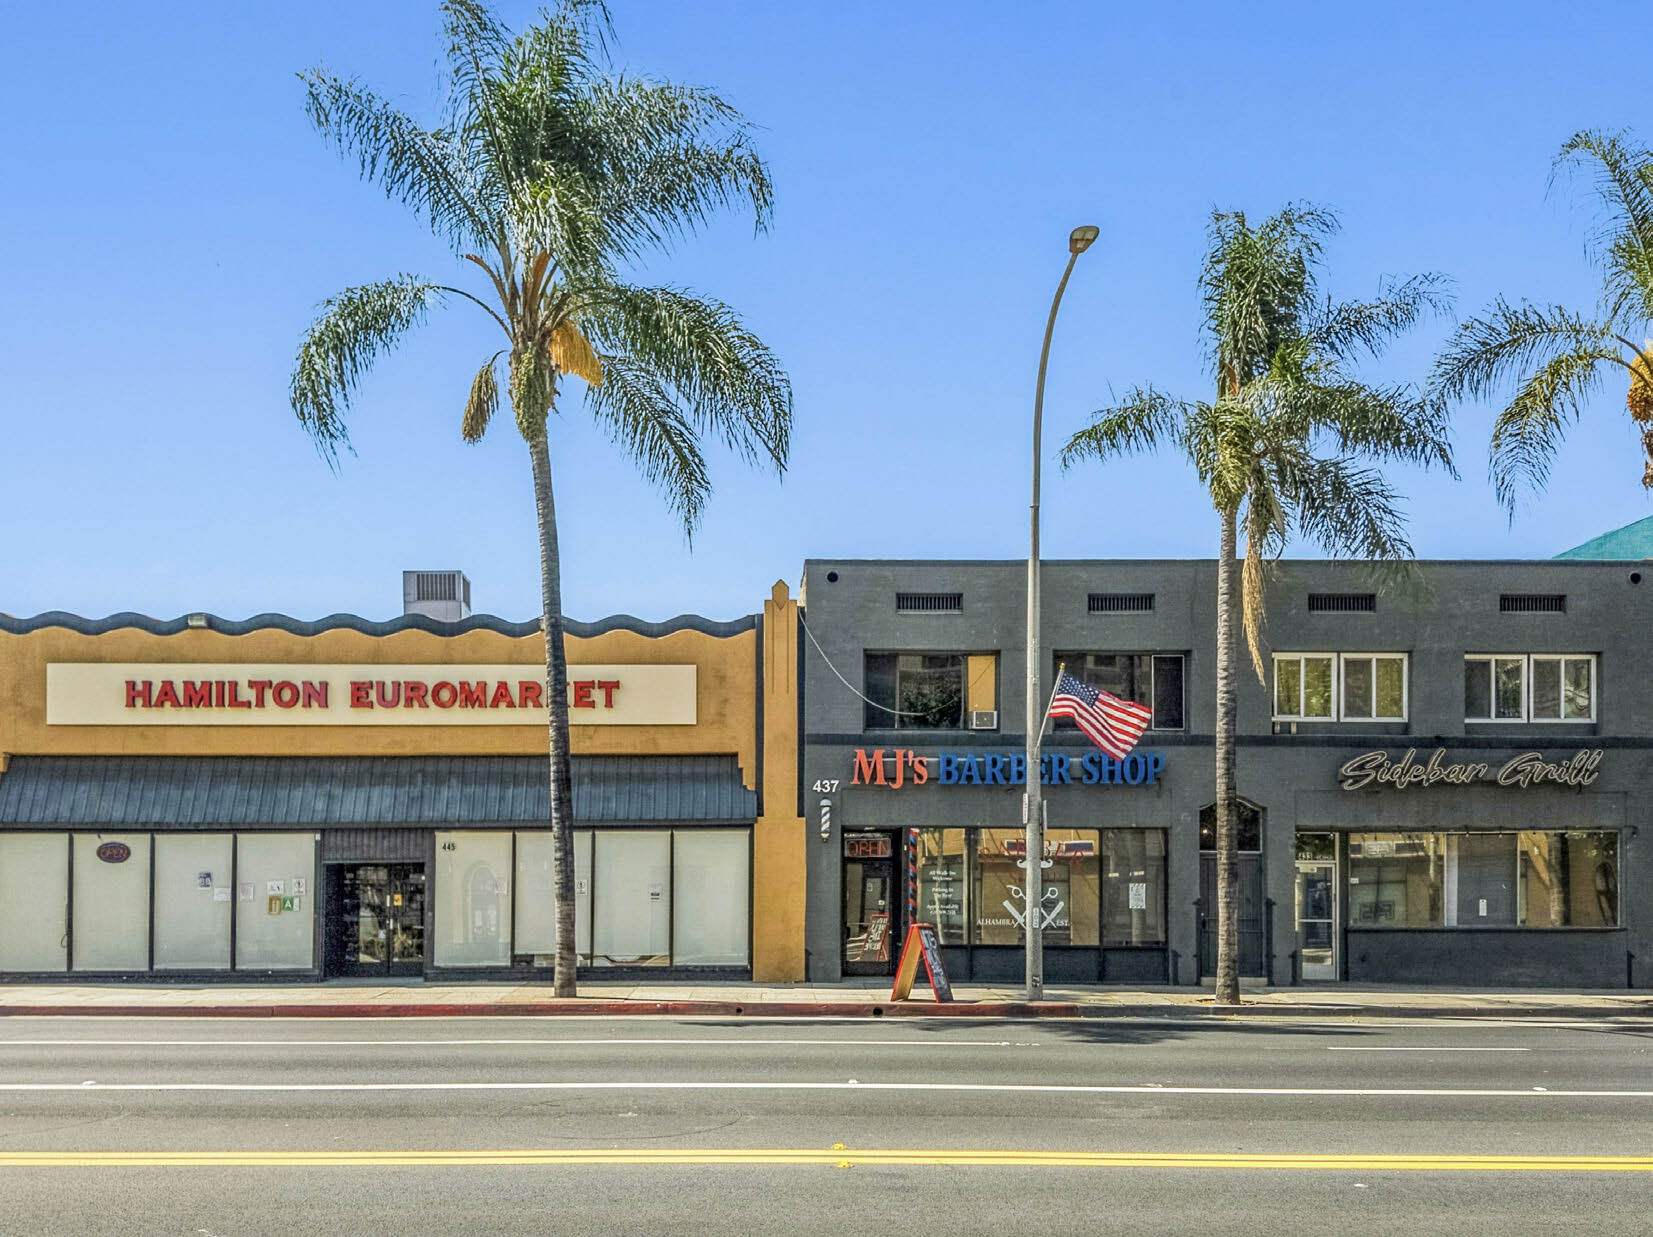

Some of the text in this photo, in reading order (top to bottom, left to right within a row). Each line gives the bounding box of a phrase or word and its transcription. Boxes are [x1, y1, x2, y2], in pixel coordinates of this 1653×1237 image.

[125, 680, 620, 709] HAMILTON EUROMARET
[851, 749, 928, 789] MJ's
[1082, 752, 1166, 785] SHOP
[1341, 747, 1604, 791] Sidebar Grill
[812, 779, 840, 793] 437
[442, 843, 456, 851] 445
[847, 840, 890, 857] OPEN
[976, 918, 1015, 926] ALHAMBRA
